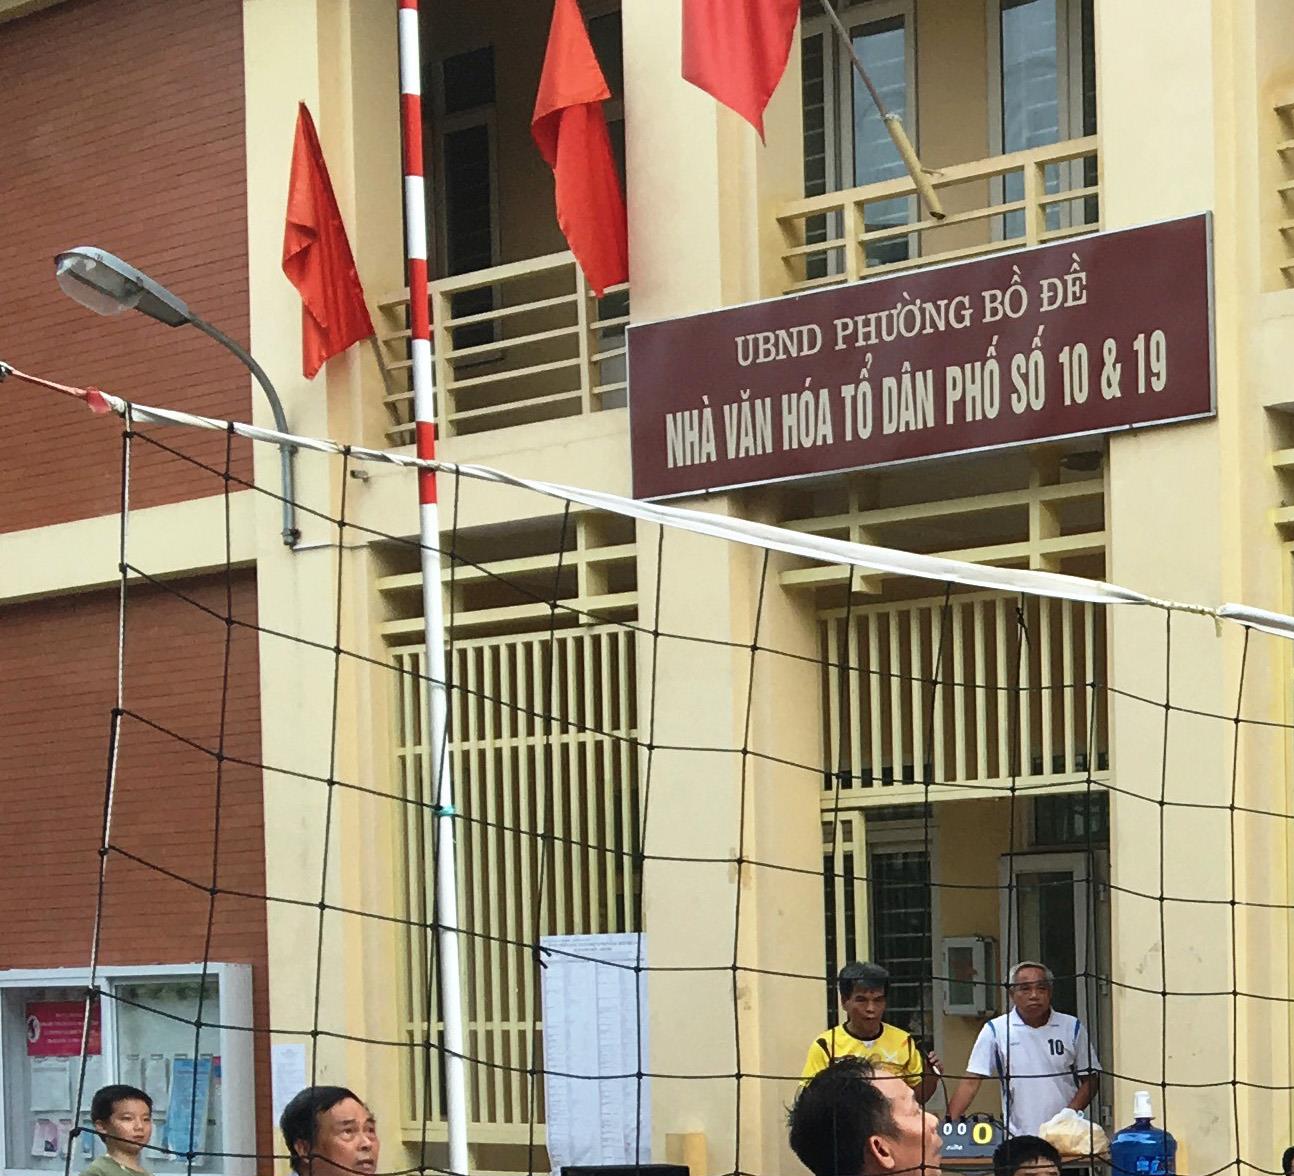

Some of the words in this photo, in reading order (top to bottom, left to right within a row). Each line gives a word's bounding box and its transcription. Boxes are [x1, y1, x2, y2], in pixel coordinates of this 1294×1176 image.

[735, 324, 822, 366] UBND
[833, 290, 973, 351] PHƯỜNG
[982, 264, 1028, 323] BỒ
[1039, 252, 1088, 311] ĐỀ
[665, 394, 716, 469] NHÀ
[723, 389, 773, 458] VĂN
[782, 374, 834, 450] HÓA
[841, 352, 873, 440] TỔ
[881, 361, 935, 434] DÂN
[946, 334, 1001, 425] PHỐ
[1011, 324, 1045, 415] SỐ
[1059, 342, 1089, 407] 10
[1102, 338, 1122, 400] &
[1133, 329, 1168, 394] 19
[1047, 1038, 1064, 1055] 10
